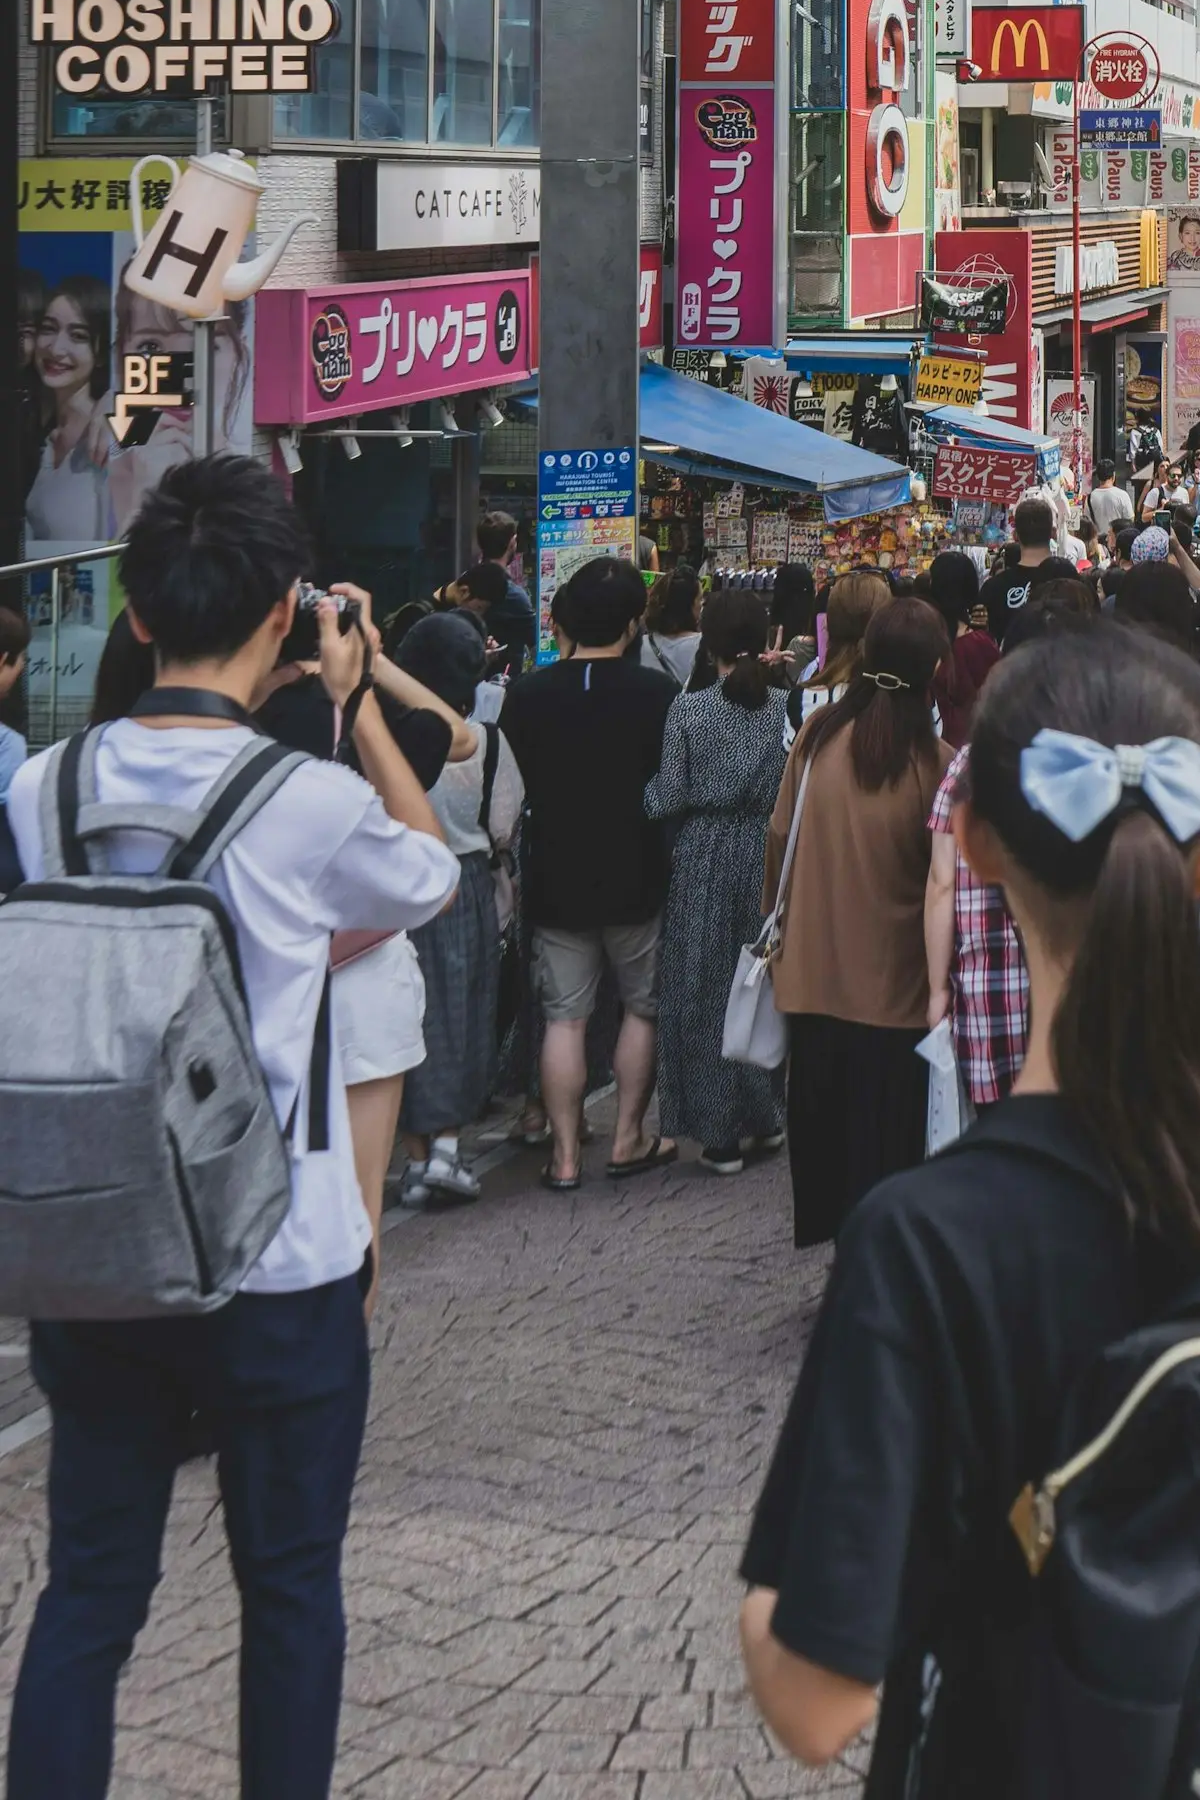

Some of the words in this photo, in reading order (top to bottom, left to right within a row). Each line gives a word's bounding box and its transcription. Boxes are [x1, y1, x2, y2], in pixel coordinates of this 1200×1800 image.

[1100, 49, 1112, 57] FIRE
[56, 46, 309, 92] COFFEE
[1095, 60, 1144, 83] 消火栓
[1095, 117, 1145, 128] 東郷神社
[1095, 131, 1148, 142] 東郷記念館
[1107, 158, 1125, 201] Pausa
[1150, 162, 1167, 200] Pausa
[415, 189, 452, 219] CAT
[458, 189, 503, 218] CAFE
[672, 349, 709, 368] 日本
[125, 354, 172, 394] BF
[920, 362, 983, 383] ハッピーワン
[916, 383, 953, 401] HAPPY
[938, 448, 1034, 470] 原宿ハッピーワン
[936, 462, 1033, 490] スクイーズ
